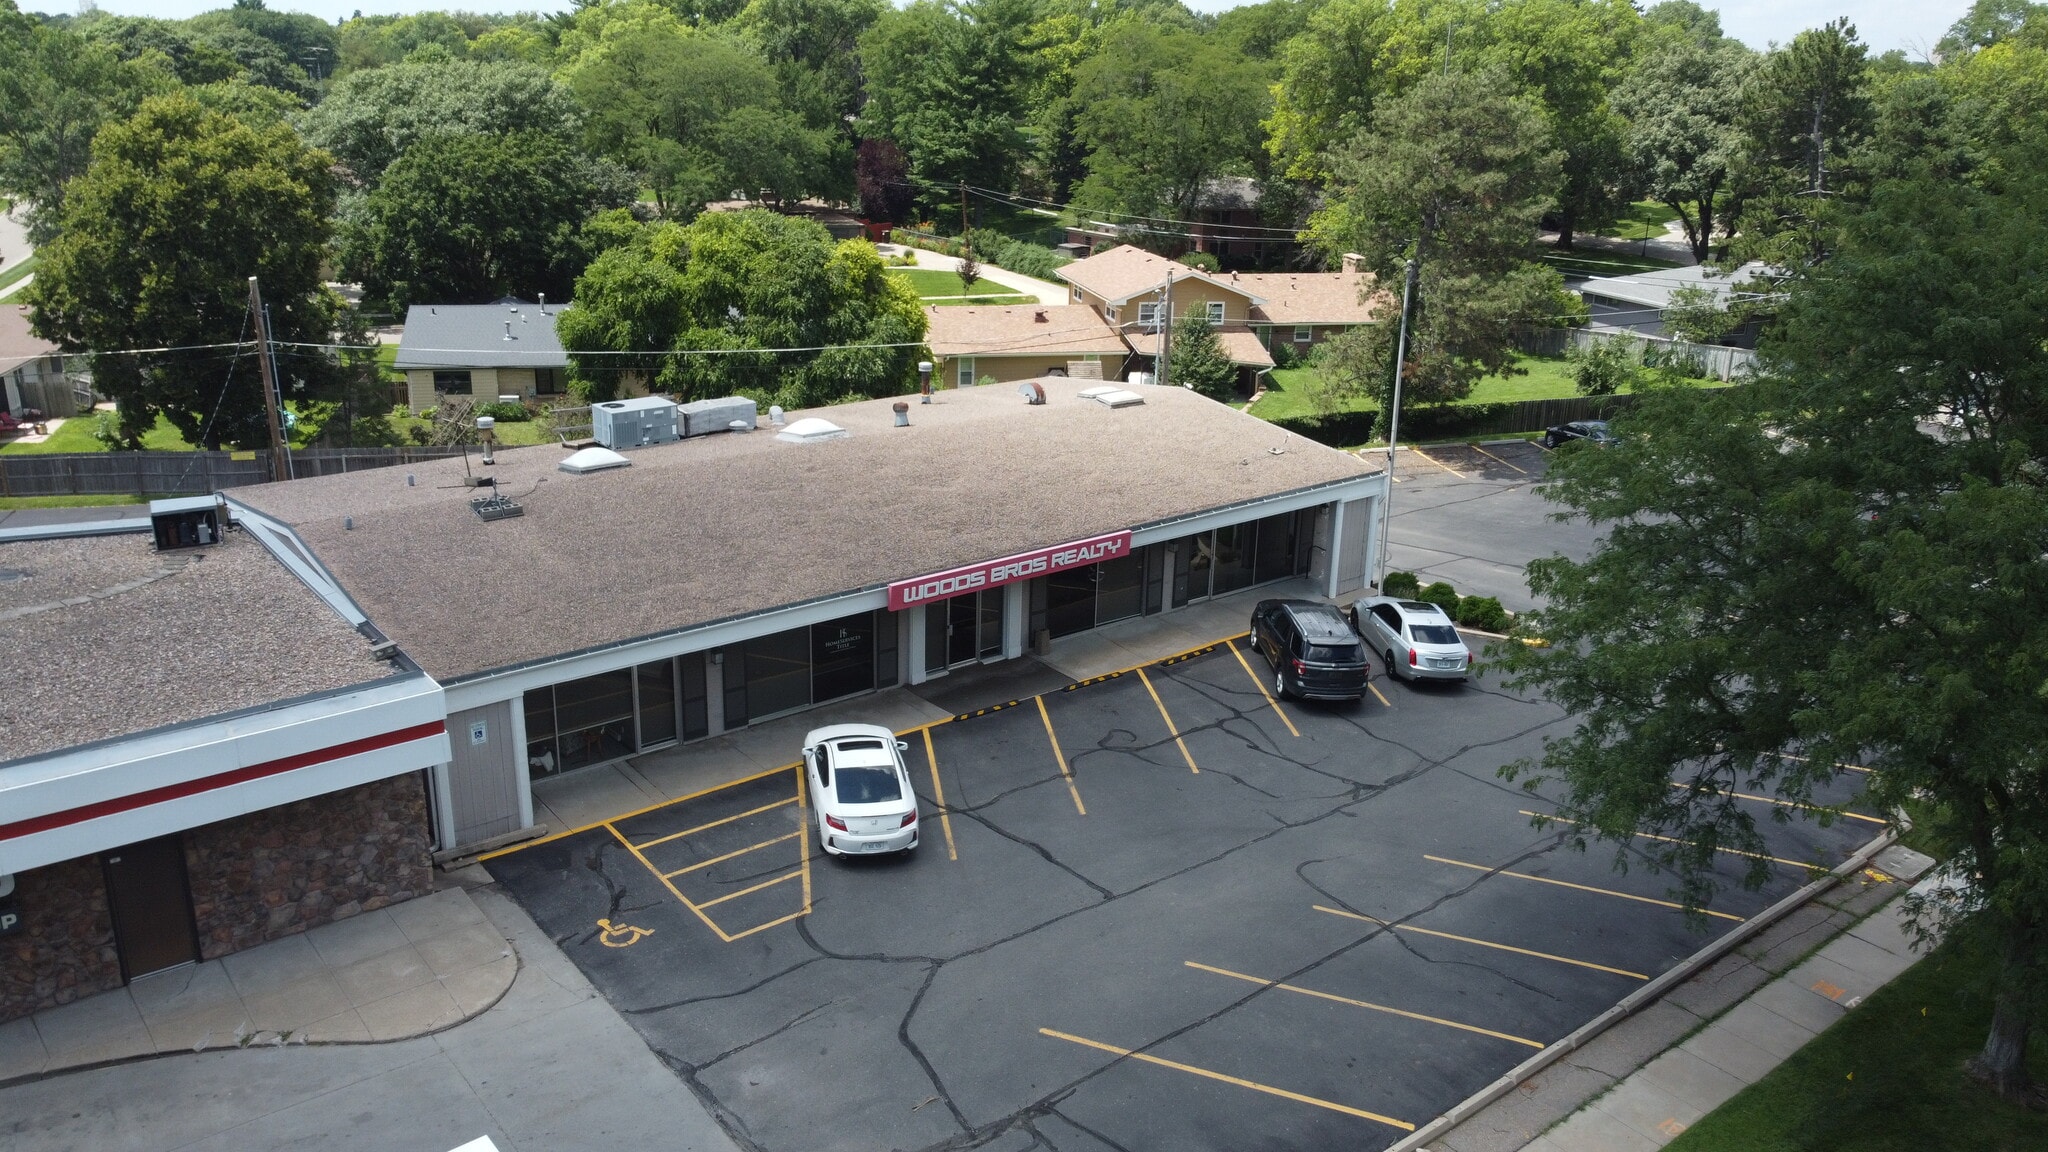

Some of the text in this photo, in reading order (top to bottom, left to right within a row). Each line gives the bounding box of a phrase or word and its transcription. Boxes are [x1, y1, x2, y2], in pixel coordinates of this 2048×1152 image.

[903, 538, 1122, 603] WOODS BROS REALTY
